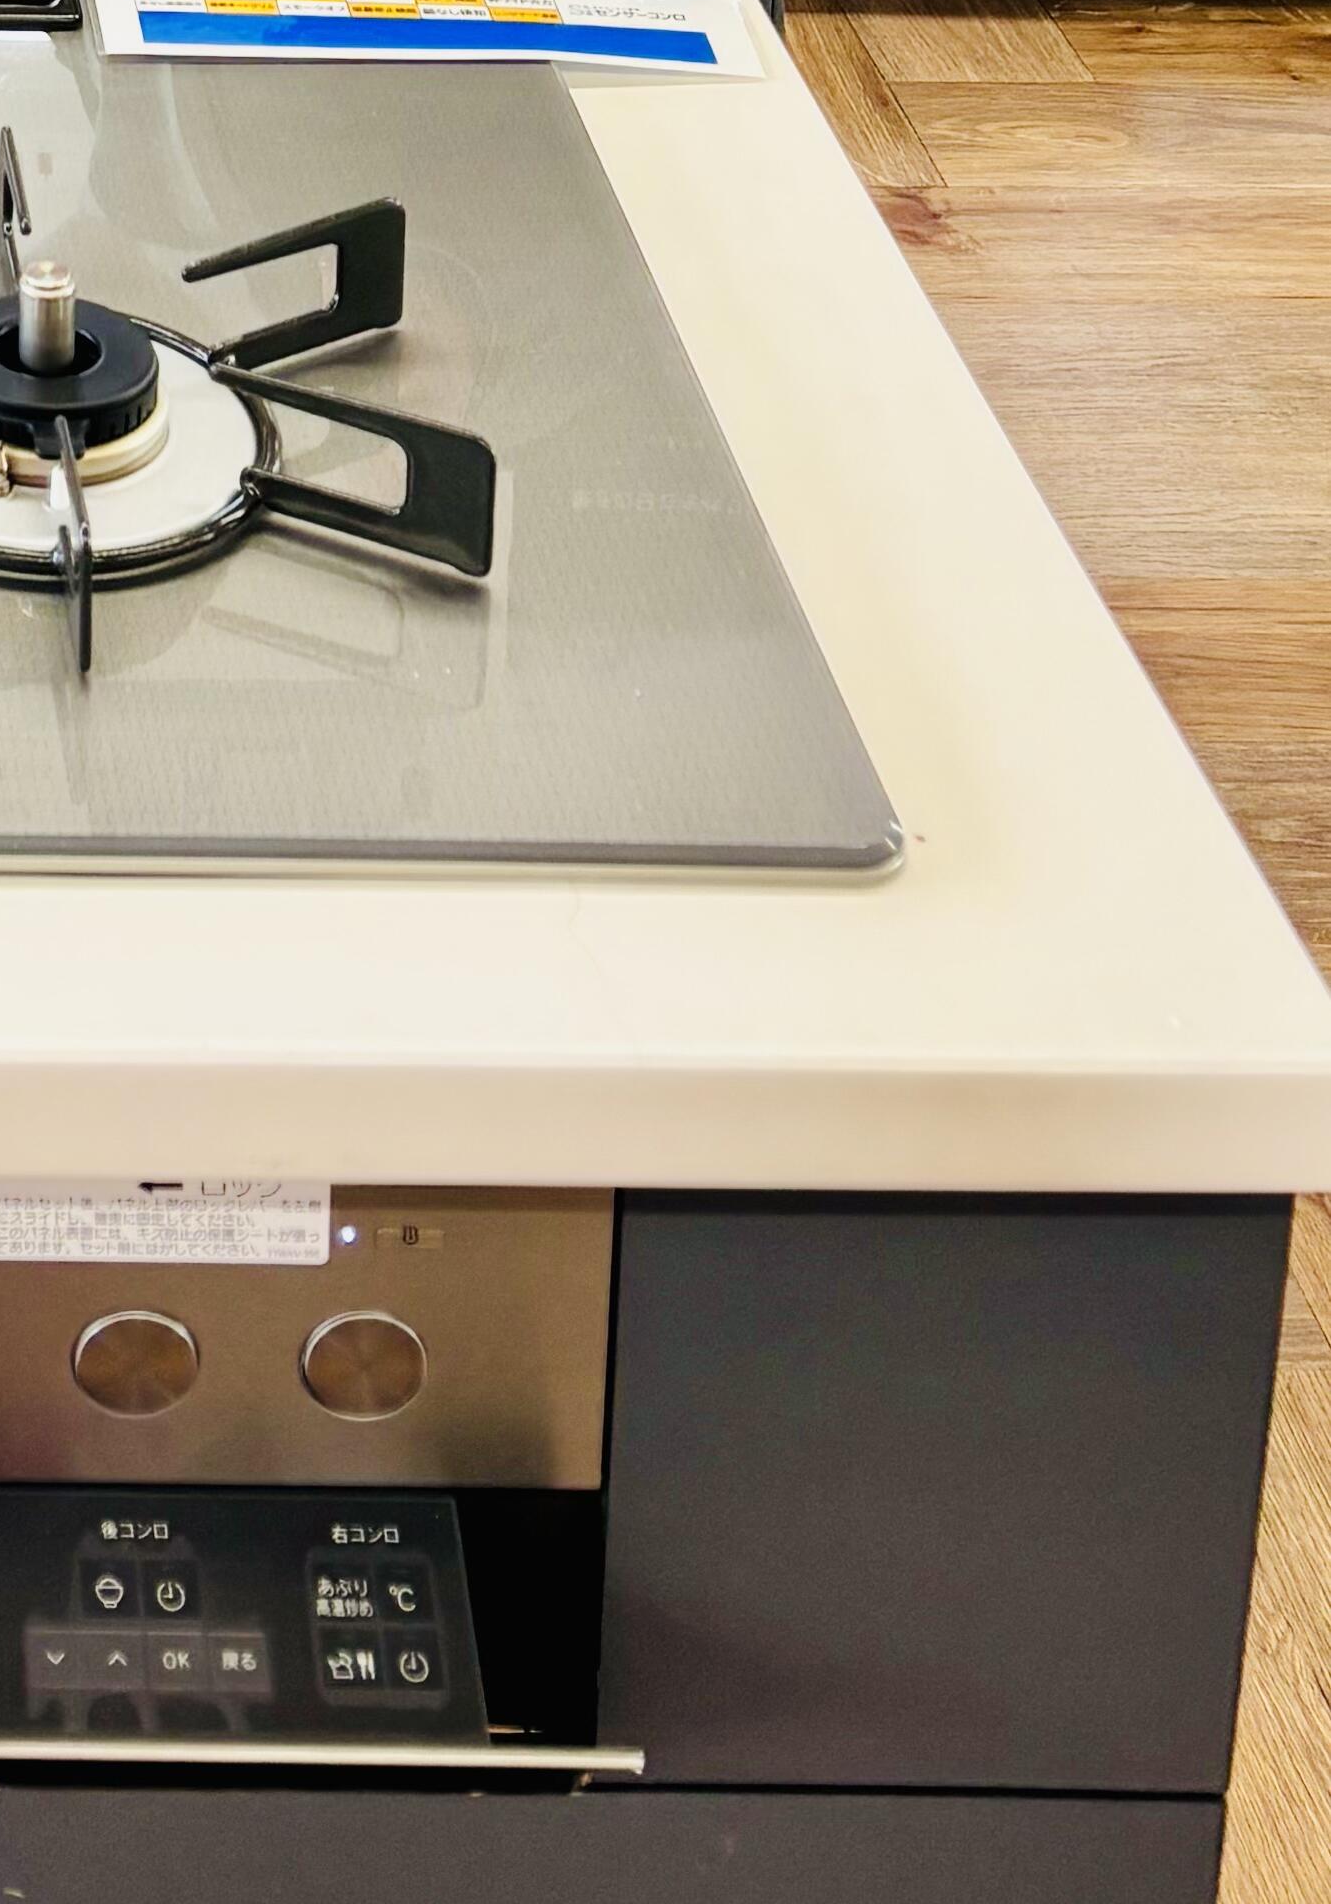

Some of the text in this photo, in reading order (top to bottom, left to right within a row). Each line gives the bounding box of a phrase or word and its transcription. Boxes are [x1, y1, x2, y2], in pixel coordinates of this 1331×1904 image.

[100, 1520, 169, 1542] 後コンロ
[331, 1523, 401, 1546] 右コンロ
[318, 1577, 369, 1598] あぶり
[315, 1597, 374, 1619] 高温炒め
[162, 1650, 191, 1671] OK
[221, 1650, 258, 1672] 戻る
